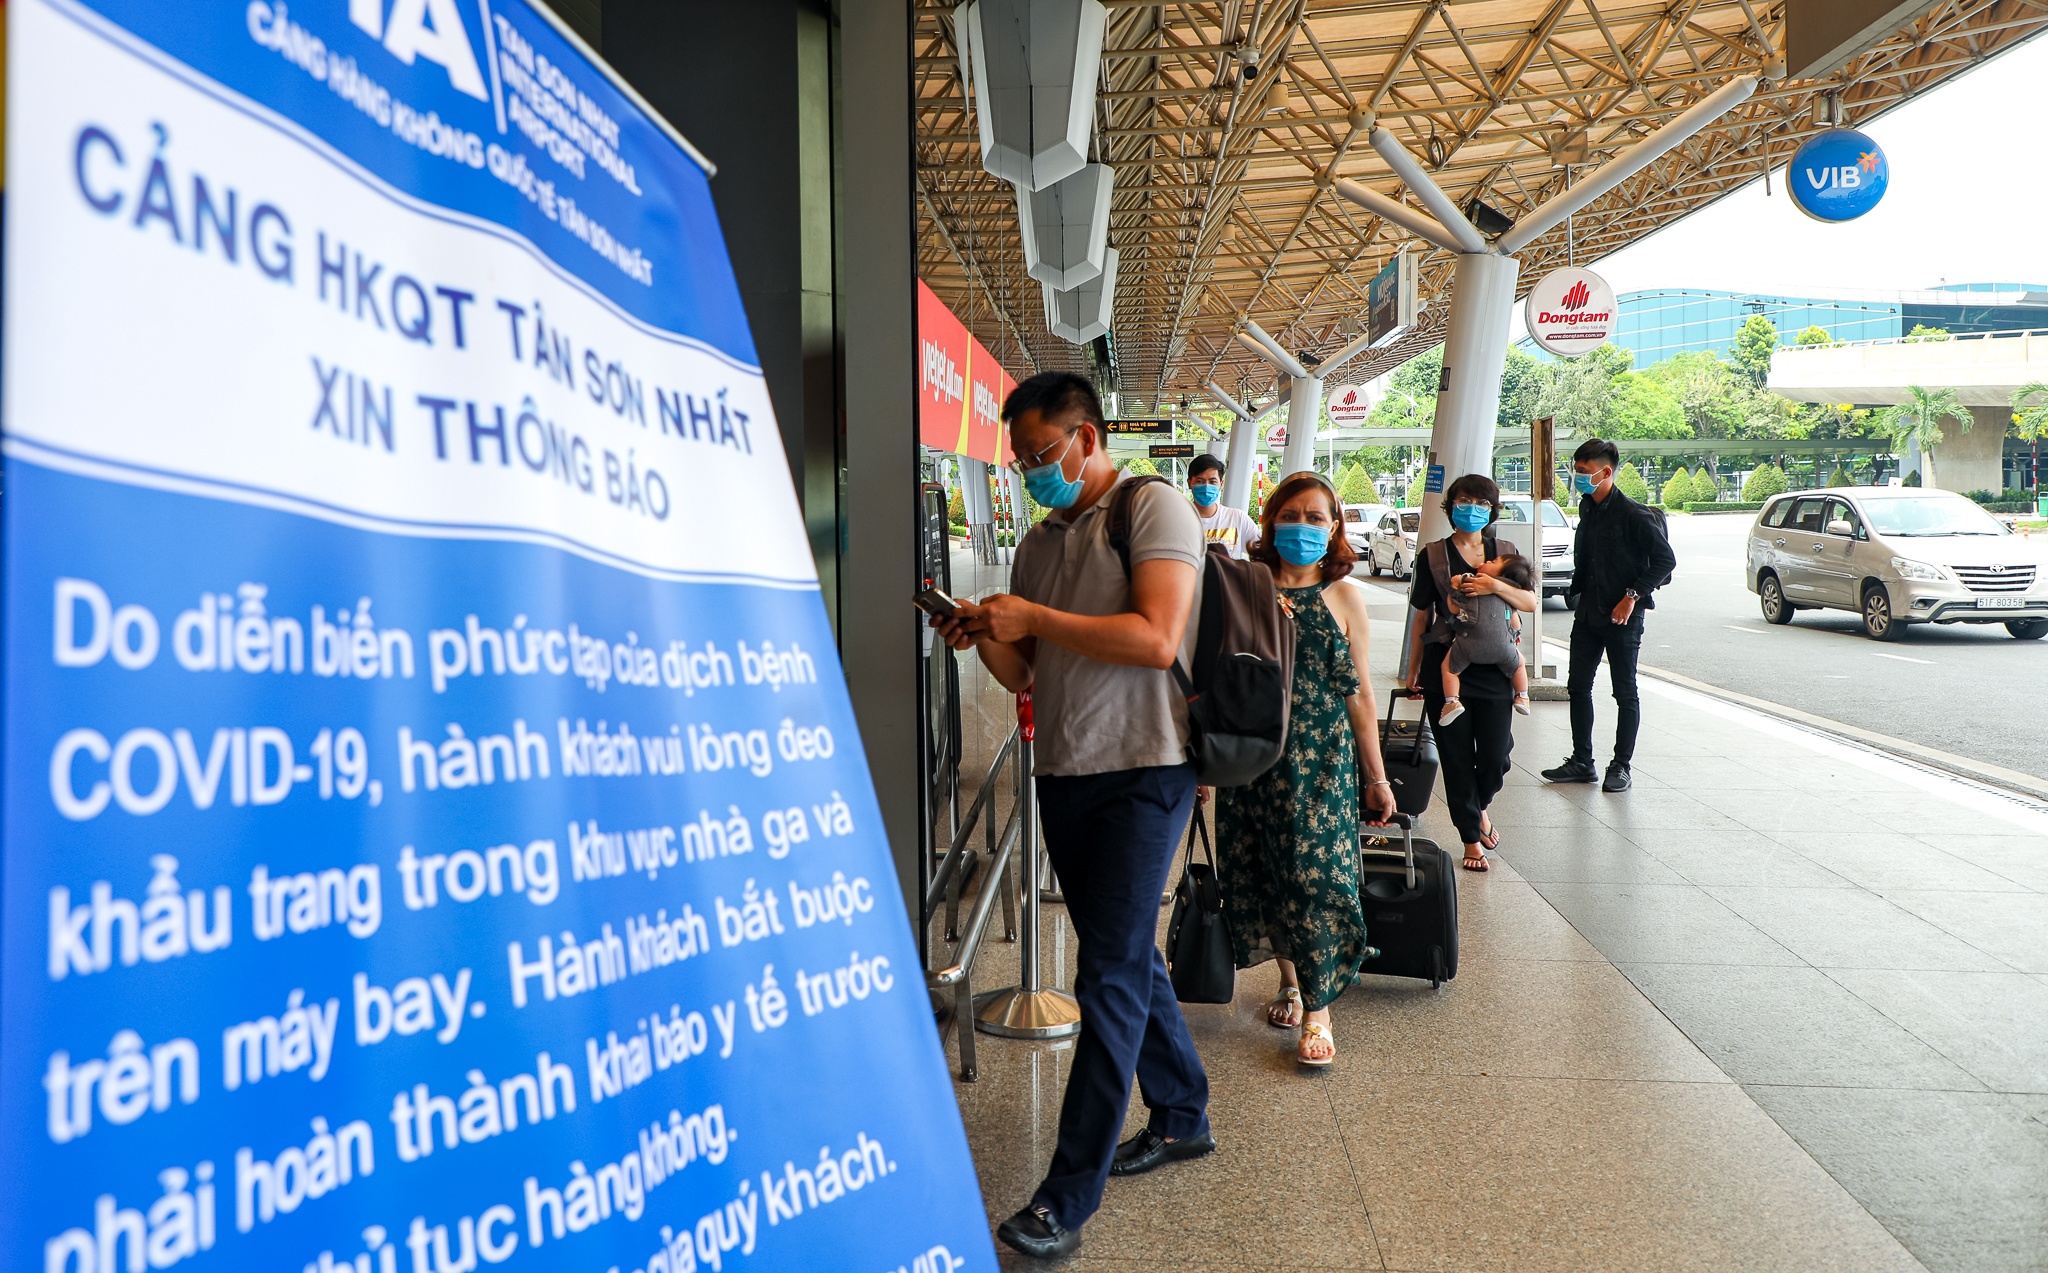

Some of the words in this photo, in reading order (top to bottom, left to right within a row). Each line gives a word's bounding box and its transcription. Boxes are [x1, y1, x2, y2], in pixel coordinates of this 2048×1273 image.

[391, 98, 486, 170] KHÔNG
[508, 93, 587, 181] AIRPORT
[1806, 166, 1861, 190] VIB
[73, 121, 296, 287] CẢNG
[317, 228, 475, 350] HKQT
[584, 347, 649, 429] SƠN
[655, 385, 753, 456] NHẤT
[1538, 311, 1608, 325] Dongtam
[310, 354, 396, 454] XIN
[416, 394, 595, 496] THÔNG
[603, 447, 670, 522] BÁO
[1331, 405, 1367, 413] Dongtam
[53, 577, 161, 670] Do
[173, 582, 303, 674] diễn
[312, 596, 414, 680] biến
[430, 613, 569, 693] phức
[611, 630, 661, 690] của
[661, 636, 736, 697] dịch
[738, 640, 818, 692] bệnh
[50, 725, 384, 822] COVID-19,
[400, 719, 551, 794] hành
[558, 717, 643, 777] khách
[642, 724, 685, 776] vui
[687, 722, 773, 778] lòng
[777, 717, 836, 763] đeo
[47, 852, 232, 982] khẩu
[248, 862, 382, 942] trang
[399, 839, 560, 912] trong
[568, 820, 627, 883] khu
[626, 824, 679, 881] vực
[681, 804, 755, 864] nhà
[762, 806, 811, 860] ga
[812, 790, 855, 838] và
[43, 1029, 200, 1144] trên
[222, 989, 341, 1090] máy
[354, 966, 488, 1048] bay.
[508, 925, 628, 1008] Hành
[627, 903, 710, 975] khách
[716, 877, 784, 950] bắt
[789, 869, 876, 929] buộc
[234, 1115, 375, 1235] hoàn
[390, 1050, 578, 1163] thành
[587, 1016, 653, 1105] khai
[652, 1004, 709, 1071] báo
[714, 1003, 738, 1061] y
[743, 965, 789, 1034] tế
[795, 948, 895, 1020] trước
[522, 1158, 645, 1248] hàng
[637, 1101, 738, 1195] không.
[695, 1180, 758, 1273] quý
[760, 1131, 897, 1227] khách.
